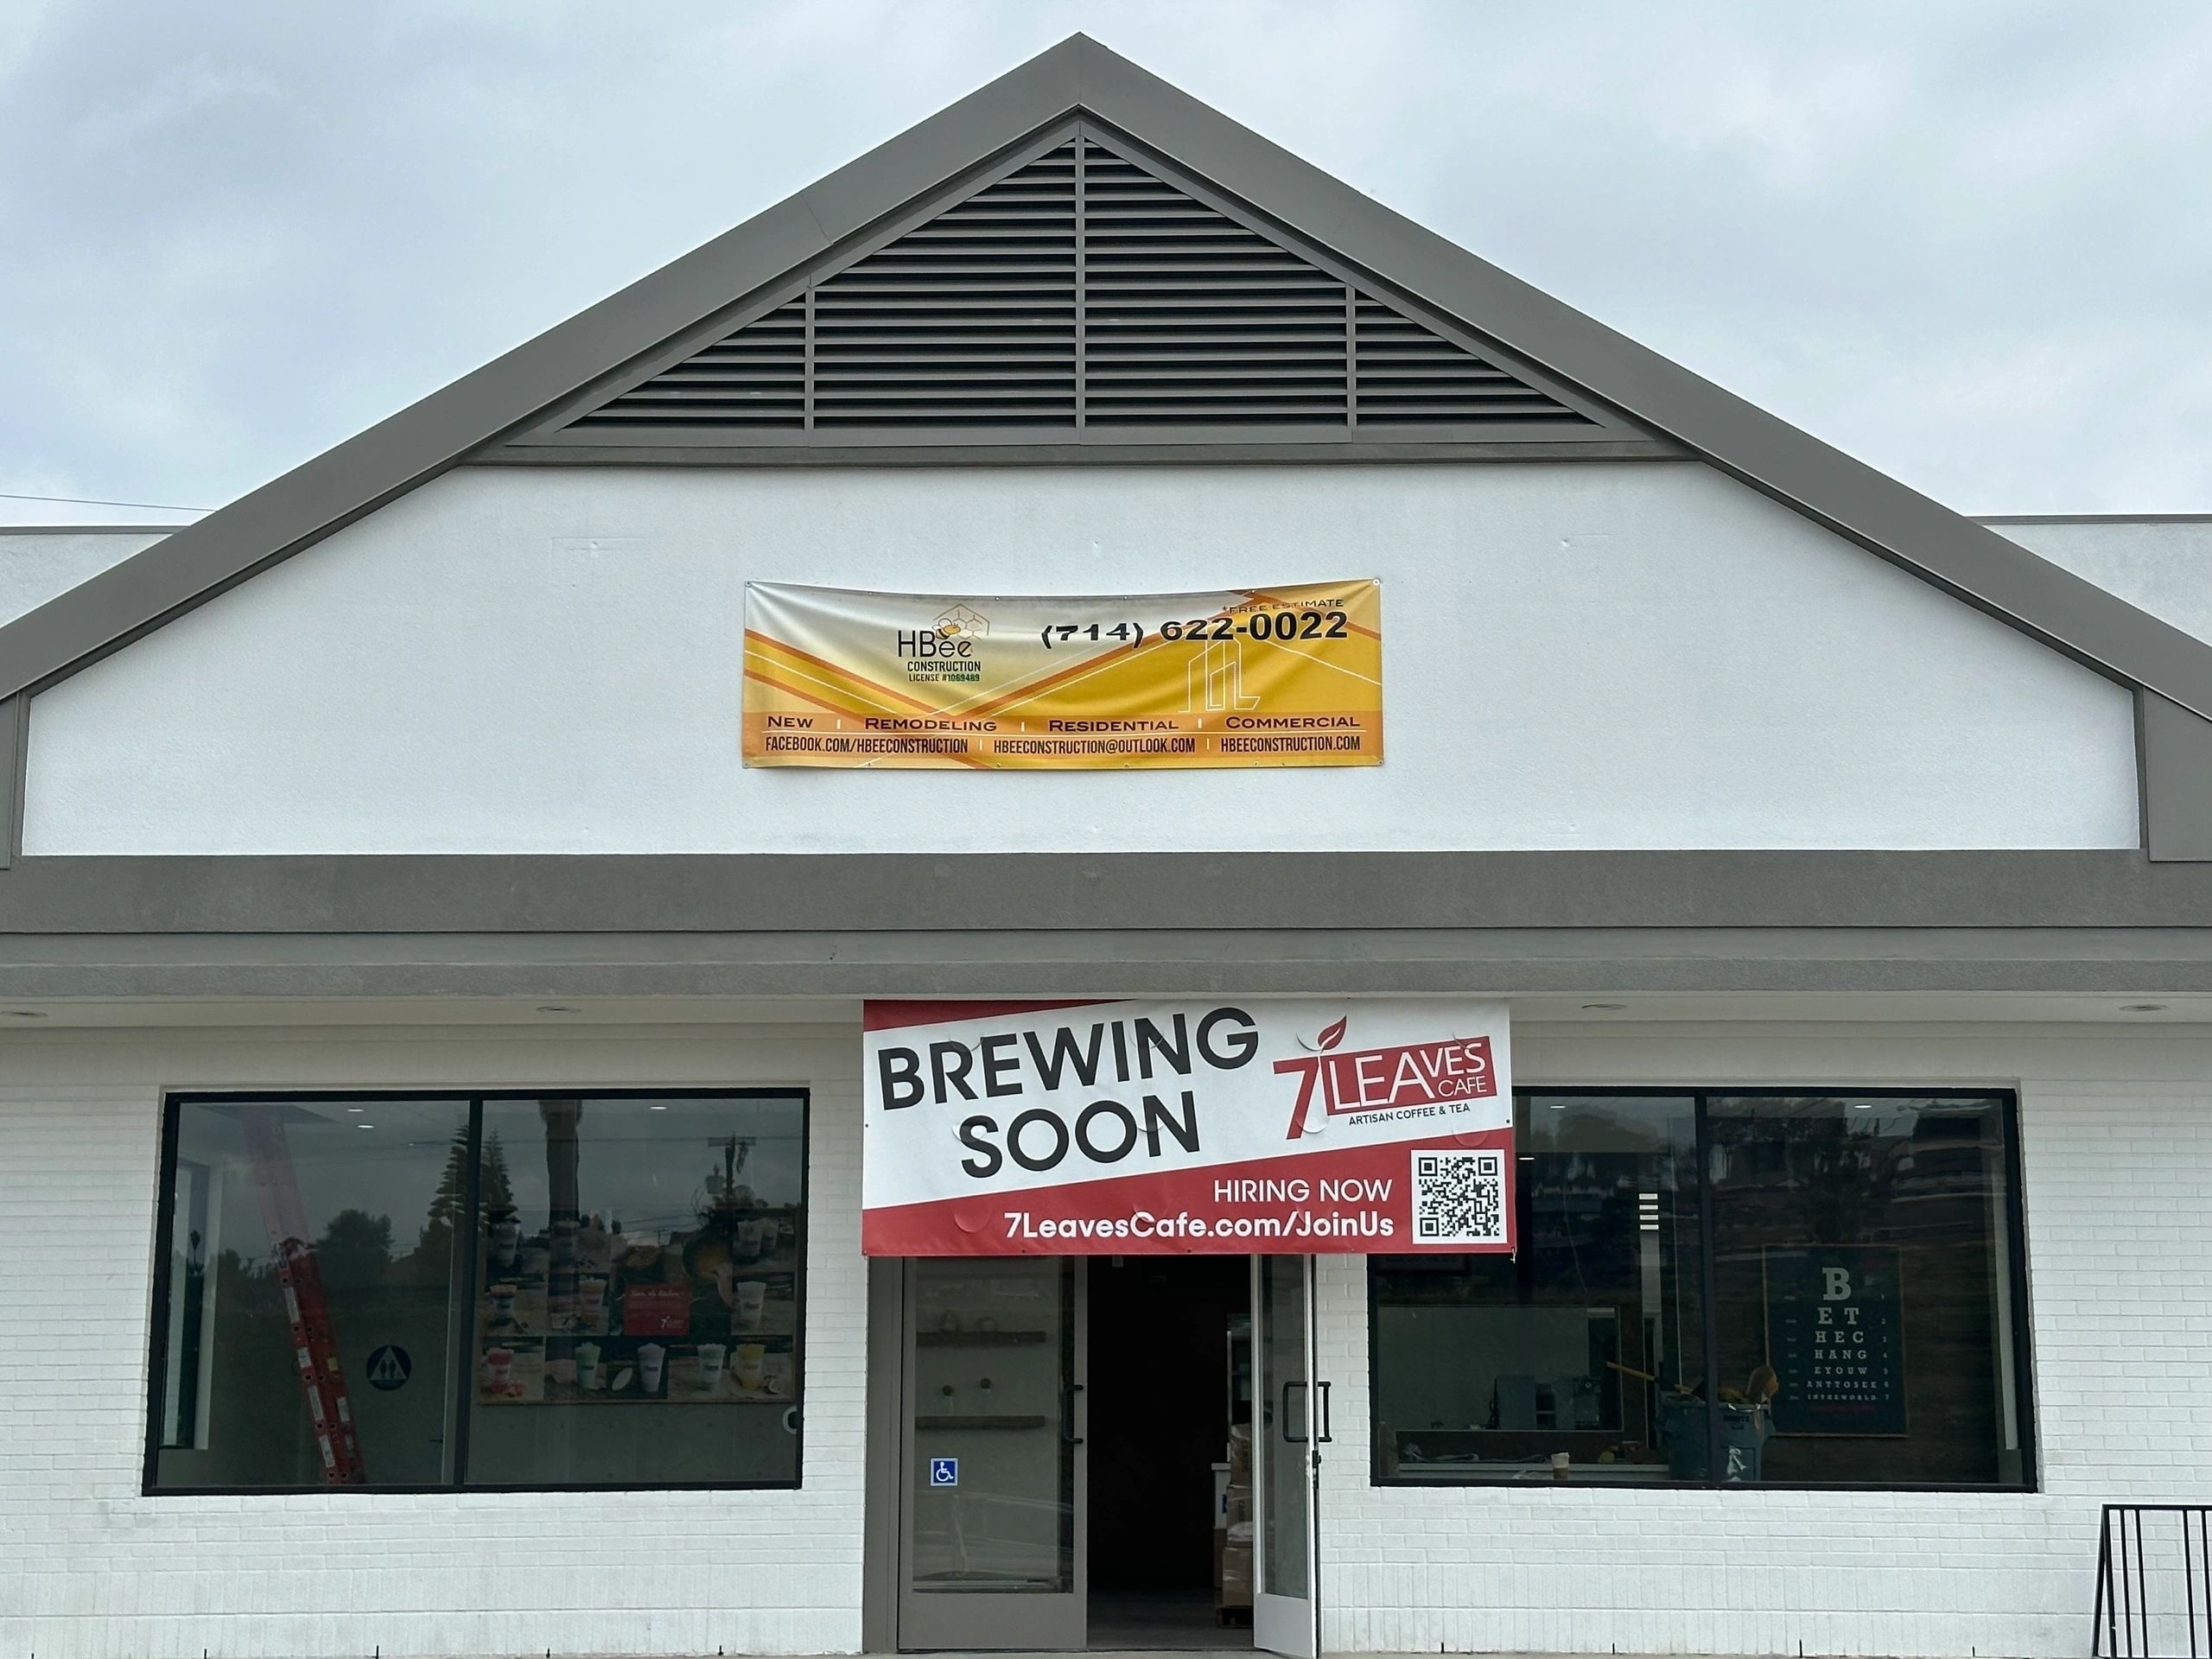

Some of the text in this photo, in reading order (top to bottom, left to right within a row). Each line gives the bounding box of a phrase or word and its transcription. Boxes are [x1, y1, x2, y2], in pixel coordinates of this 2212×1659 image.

[1272, 599, 1344, 610] ESTIMATE
[1041, 612, 1348, 649] (714) 622-0022
[898, 630, 973, 658] HBee
[907, 661, 982, 672] CONSTRUCTION
[909, 673, 939, 682] LICENSE
[766, 736, 1361, 754] FACEBOOK.COM/HBEECONSTRUCTION HBEECONSTRUCTION@OUTLOOK.COM HBEECONSTRUCTION.COM
[878, 1007, 1259, 1110] BREWING
[1328, 1042, 1485, 1110] LEAVES
[1437, 1076, 1487, 1097] CAFE
[1348, 1114, 1394, 1126] ARTISAN
[1395, 1108, 1436, 1121] COFFEE
[1448, 1104, 1471, 1114] TEA
[959, 1090, 1200, 1179] SOON
[1213, 1179, 1393, 1203] HIRING NOW
[1004, 1211, 1395, 1239] 7LeavesCafe.com/JoinUs
[1821, 1267, 1852, 1300] B
